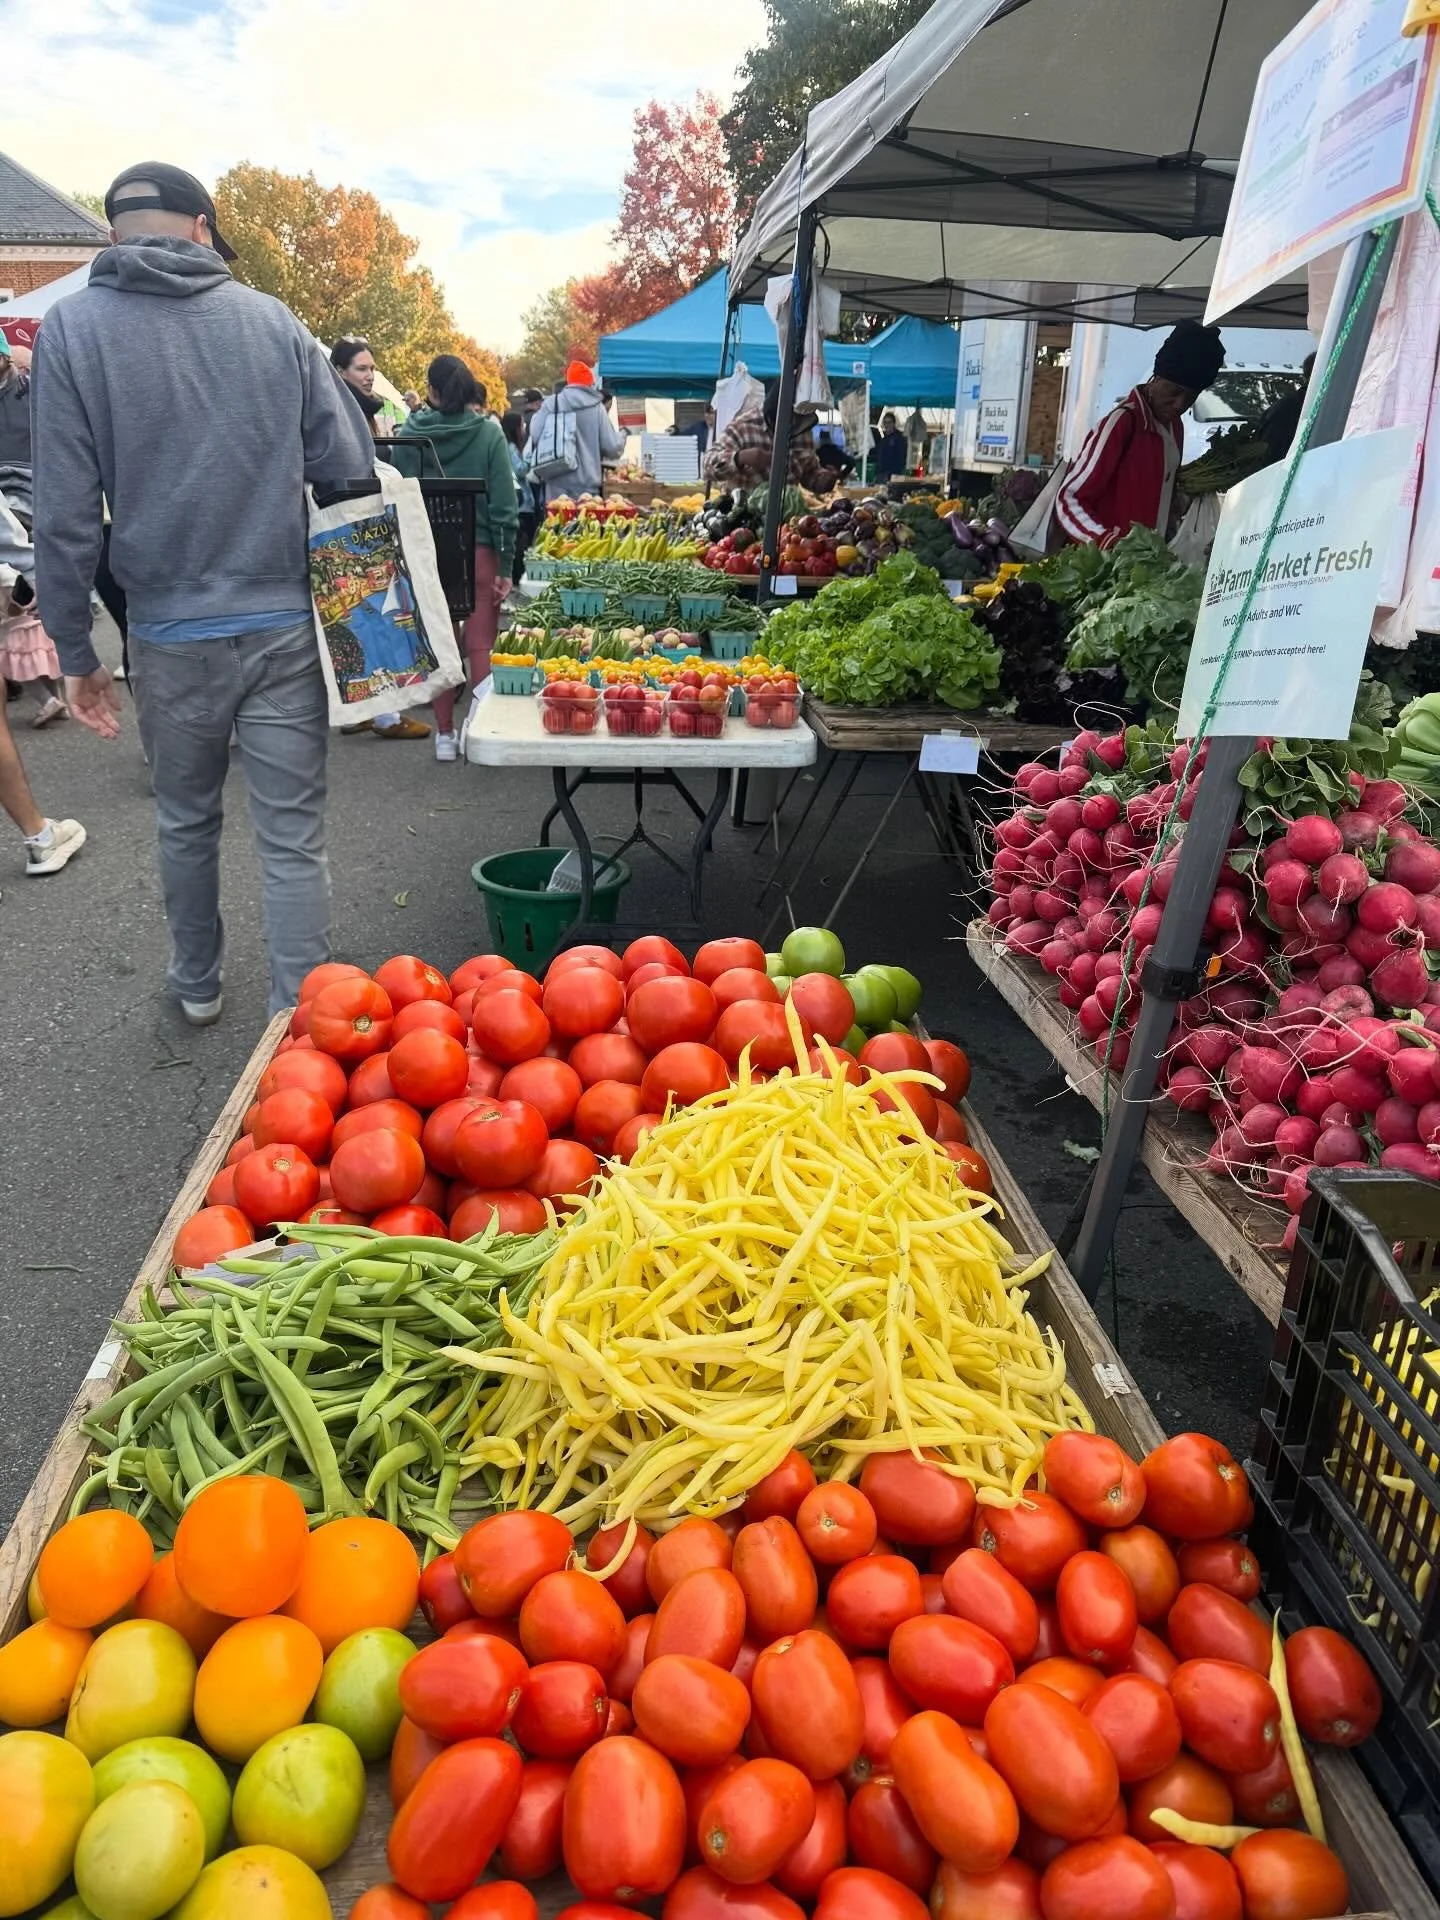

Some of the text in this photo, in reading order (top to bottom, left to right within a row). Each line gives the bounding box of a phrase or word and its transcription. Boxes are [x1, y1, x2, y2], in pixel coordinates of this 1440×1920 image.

[1240, 535, 1248, 545] We
[1273, 516, 1315, 535] participate
[1316, 513, 1325, 525] in
[1223, 569, 1251, 594] Farm
[1313, 540, 1373, 575] Fresh
[1268, 605, 1285, 619] and
[1285, 603, 1303, 617] WIC
[1277, 644, 1306, 657] accepted
[1306, 644, 1326, 654] here!
